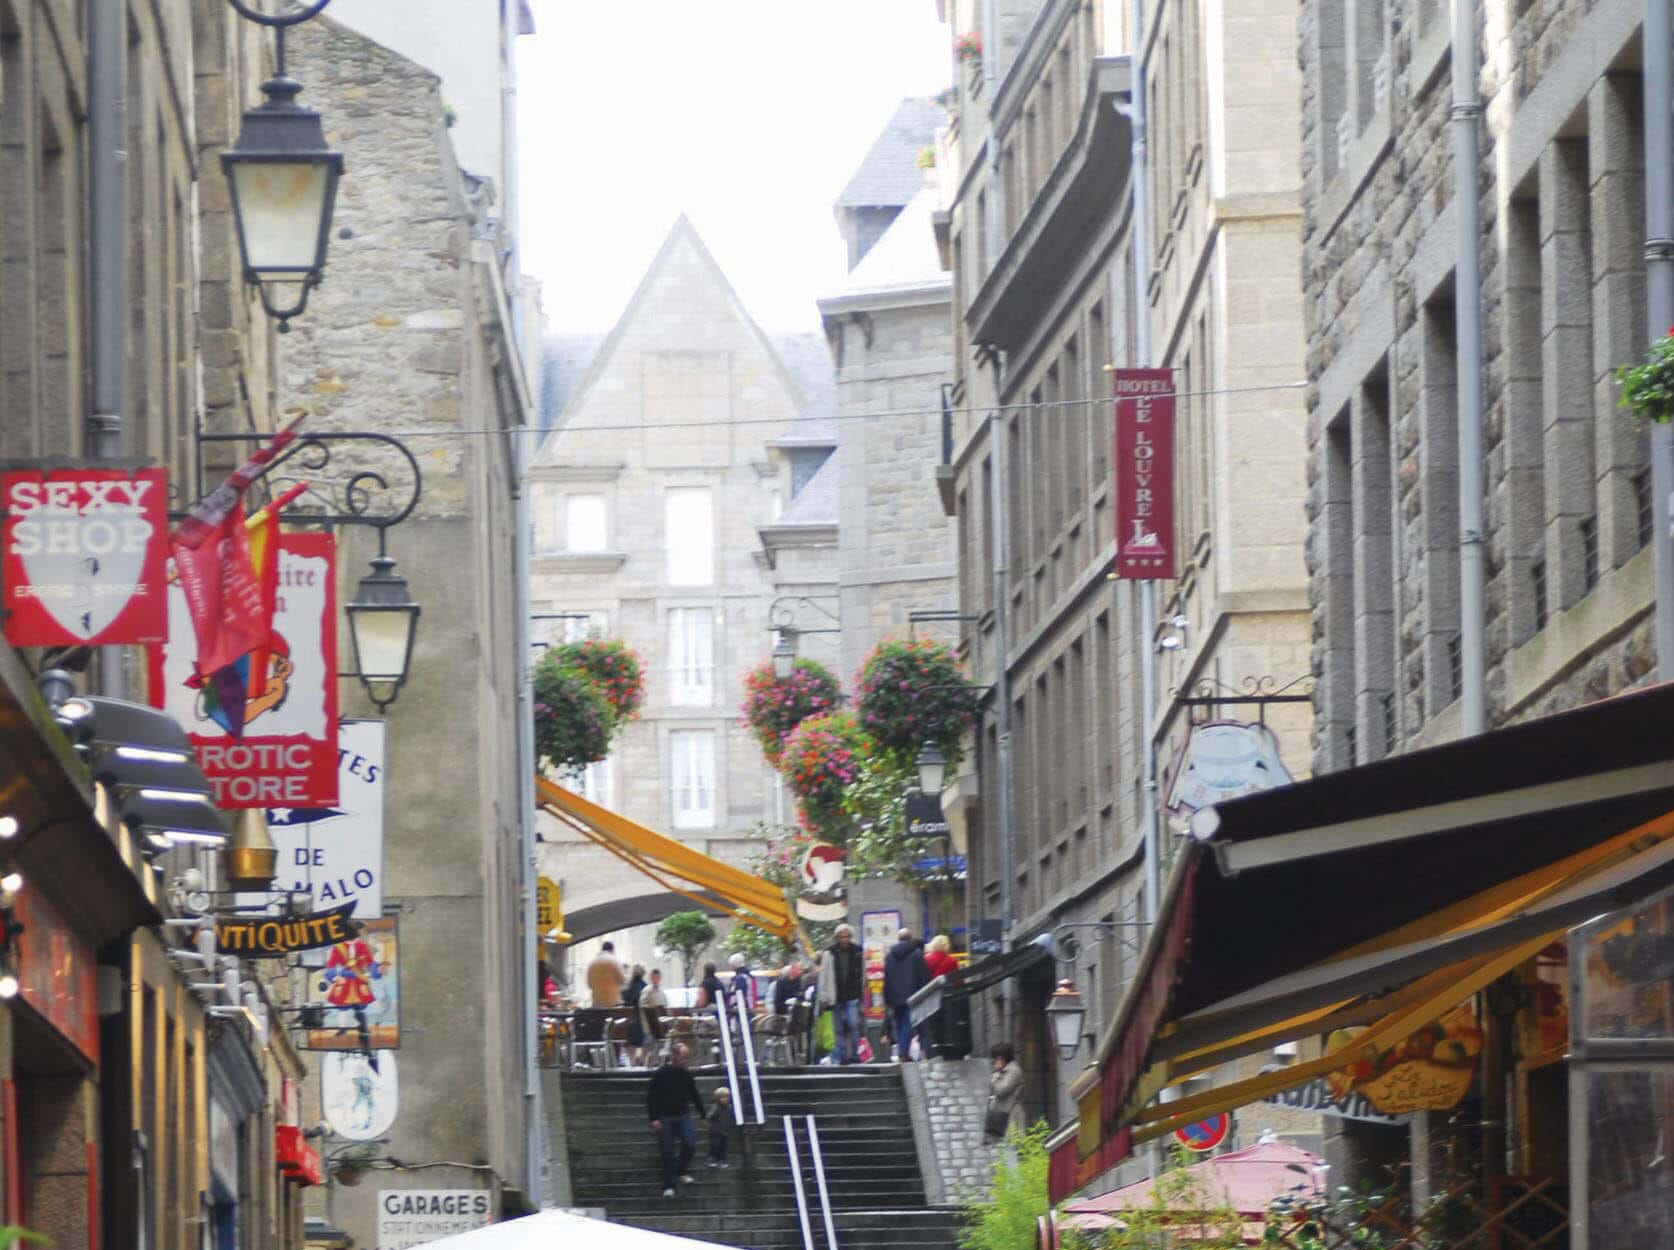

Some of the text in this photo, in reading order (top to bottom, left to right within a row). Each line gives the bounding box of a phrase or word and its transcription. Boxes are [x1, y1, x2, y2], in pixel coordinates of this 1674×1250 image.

[1117, 380, 1171, 392] HOTEL
[1134, 431, 1154, 517] LOUVRE
[9, 480, 153, 516] SEXY
[10, 519, 154, 555] SHOP
[195, 744, 312, 770] ROTIC
[338, 749, 381, 783] TES
[207, 775, 309, 801] TORE
[294, 848, 325, 866] DE
[385, 1194, 488, 1215] GARAGES
